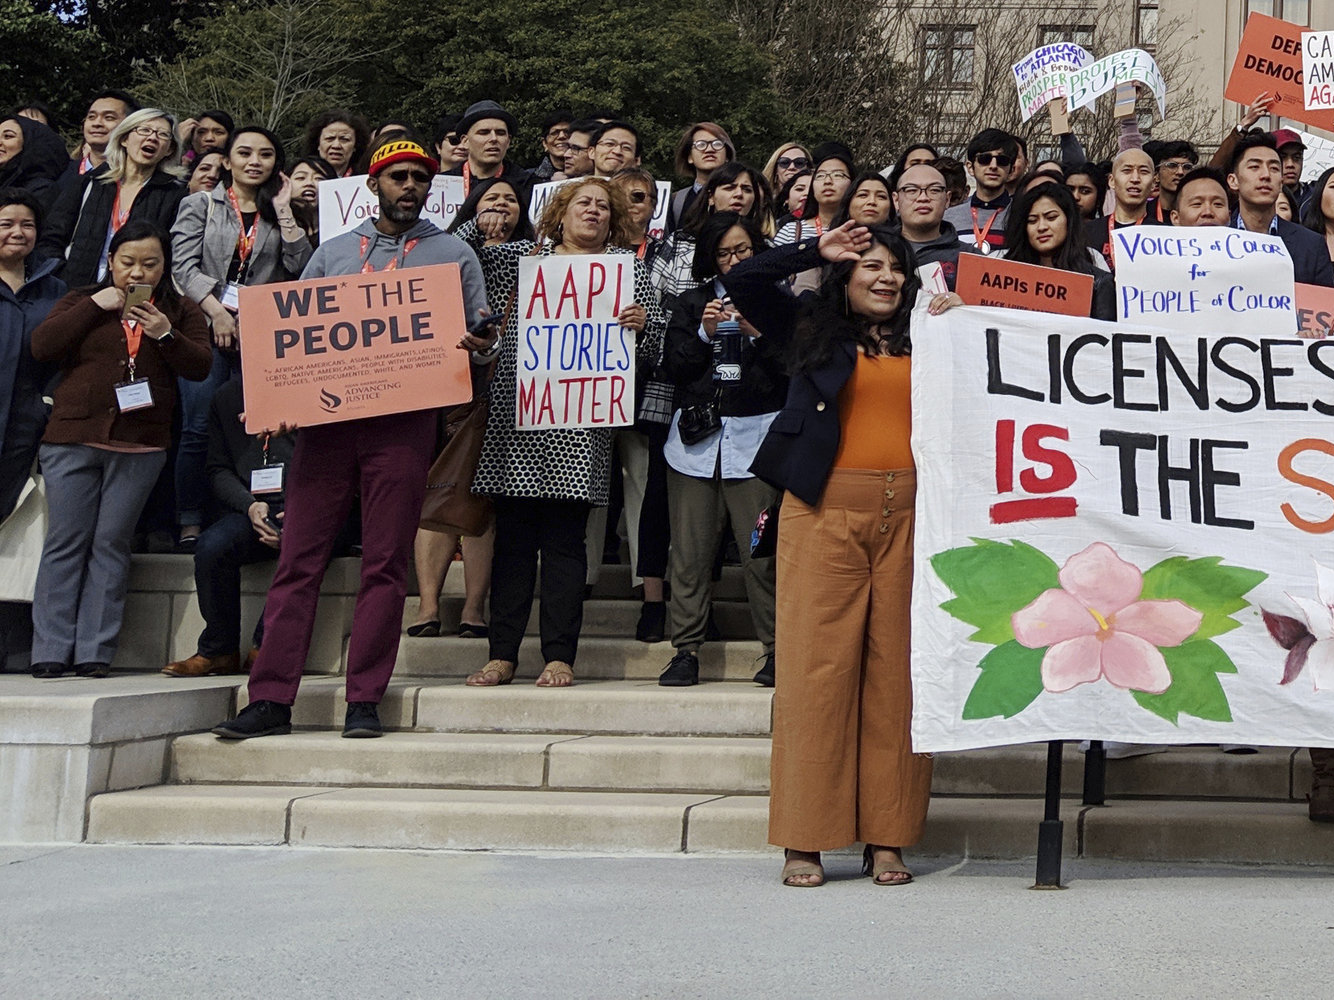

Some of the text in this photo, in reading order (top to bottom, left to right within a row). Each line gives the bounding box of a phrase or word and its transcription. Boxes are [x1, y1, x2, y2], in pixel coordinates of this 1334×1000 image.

[1014, 44, 1085, 76] From CHICAGO
[1271, 35, 1302, 56] DEF
[1019, 64, 1079, 95] Black & Brow
[1021, 53, 1083, 81] to ATLANTA
[1070, 50, 1142, 93] PROTECT
[1244, 54, 1303, 85] DEMOC
[1021, 73, 1067, 109] PROSPER
[1027, 85, 1066, 116] MATTE
[334, 186, 380, 226] Voic
[1117, 233, 1202, 263] VOICES
[1210, 240, 1221, 252] of
[980, 272, 1068, 301] AAPIs FOR
[1188, 263, 1211, 281] for
[358, 278, 427, 309] THE
[525, 262, 623, 320] AAPI
[1121, 285, 1201, 319] PEOPLE
[1211, 293, 1224, 306] of
[274, 311, 434, 359] PEOPLE
[524, 322, 632, 372] STORIES
[265, 353, 448, 382] LGBTQ, NATIVE AMERICANS, PEOPLE WITH DISABILITIES,
[274, 360, 441, 388] REFUGEES, UNDOCUMENTED, WHITE, AND WOMEN
[275, 364, 304, 374] AFRICAN
[306, 359, 347, 369] AMERICANS,
[349, 356, 372, 365] ASIAN,
[344, 381, 401, 396] ADVANCING
[345, 392, 381, 404] JUSTICE
[518, 375, 628, 427] MATTER
[996, 420, 1077, 494] IS
[1100, 429, 1255, 530] THE
